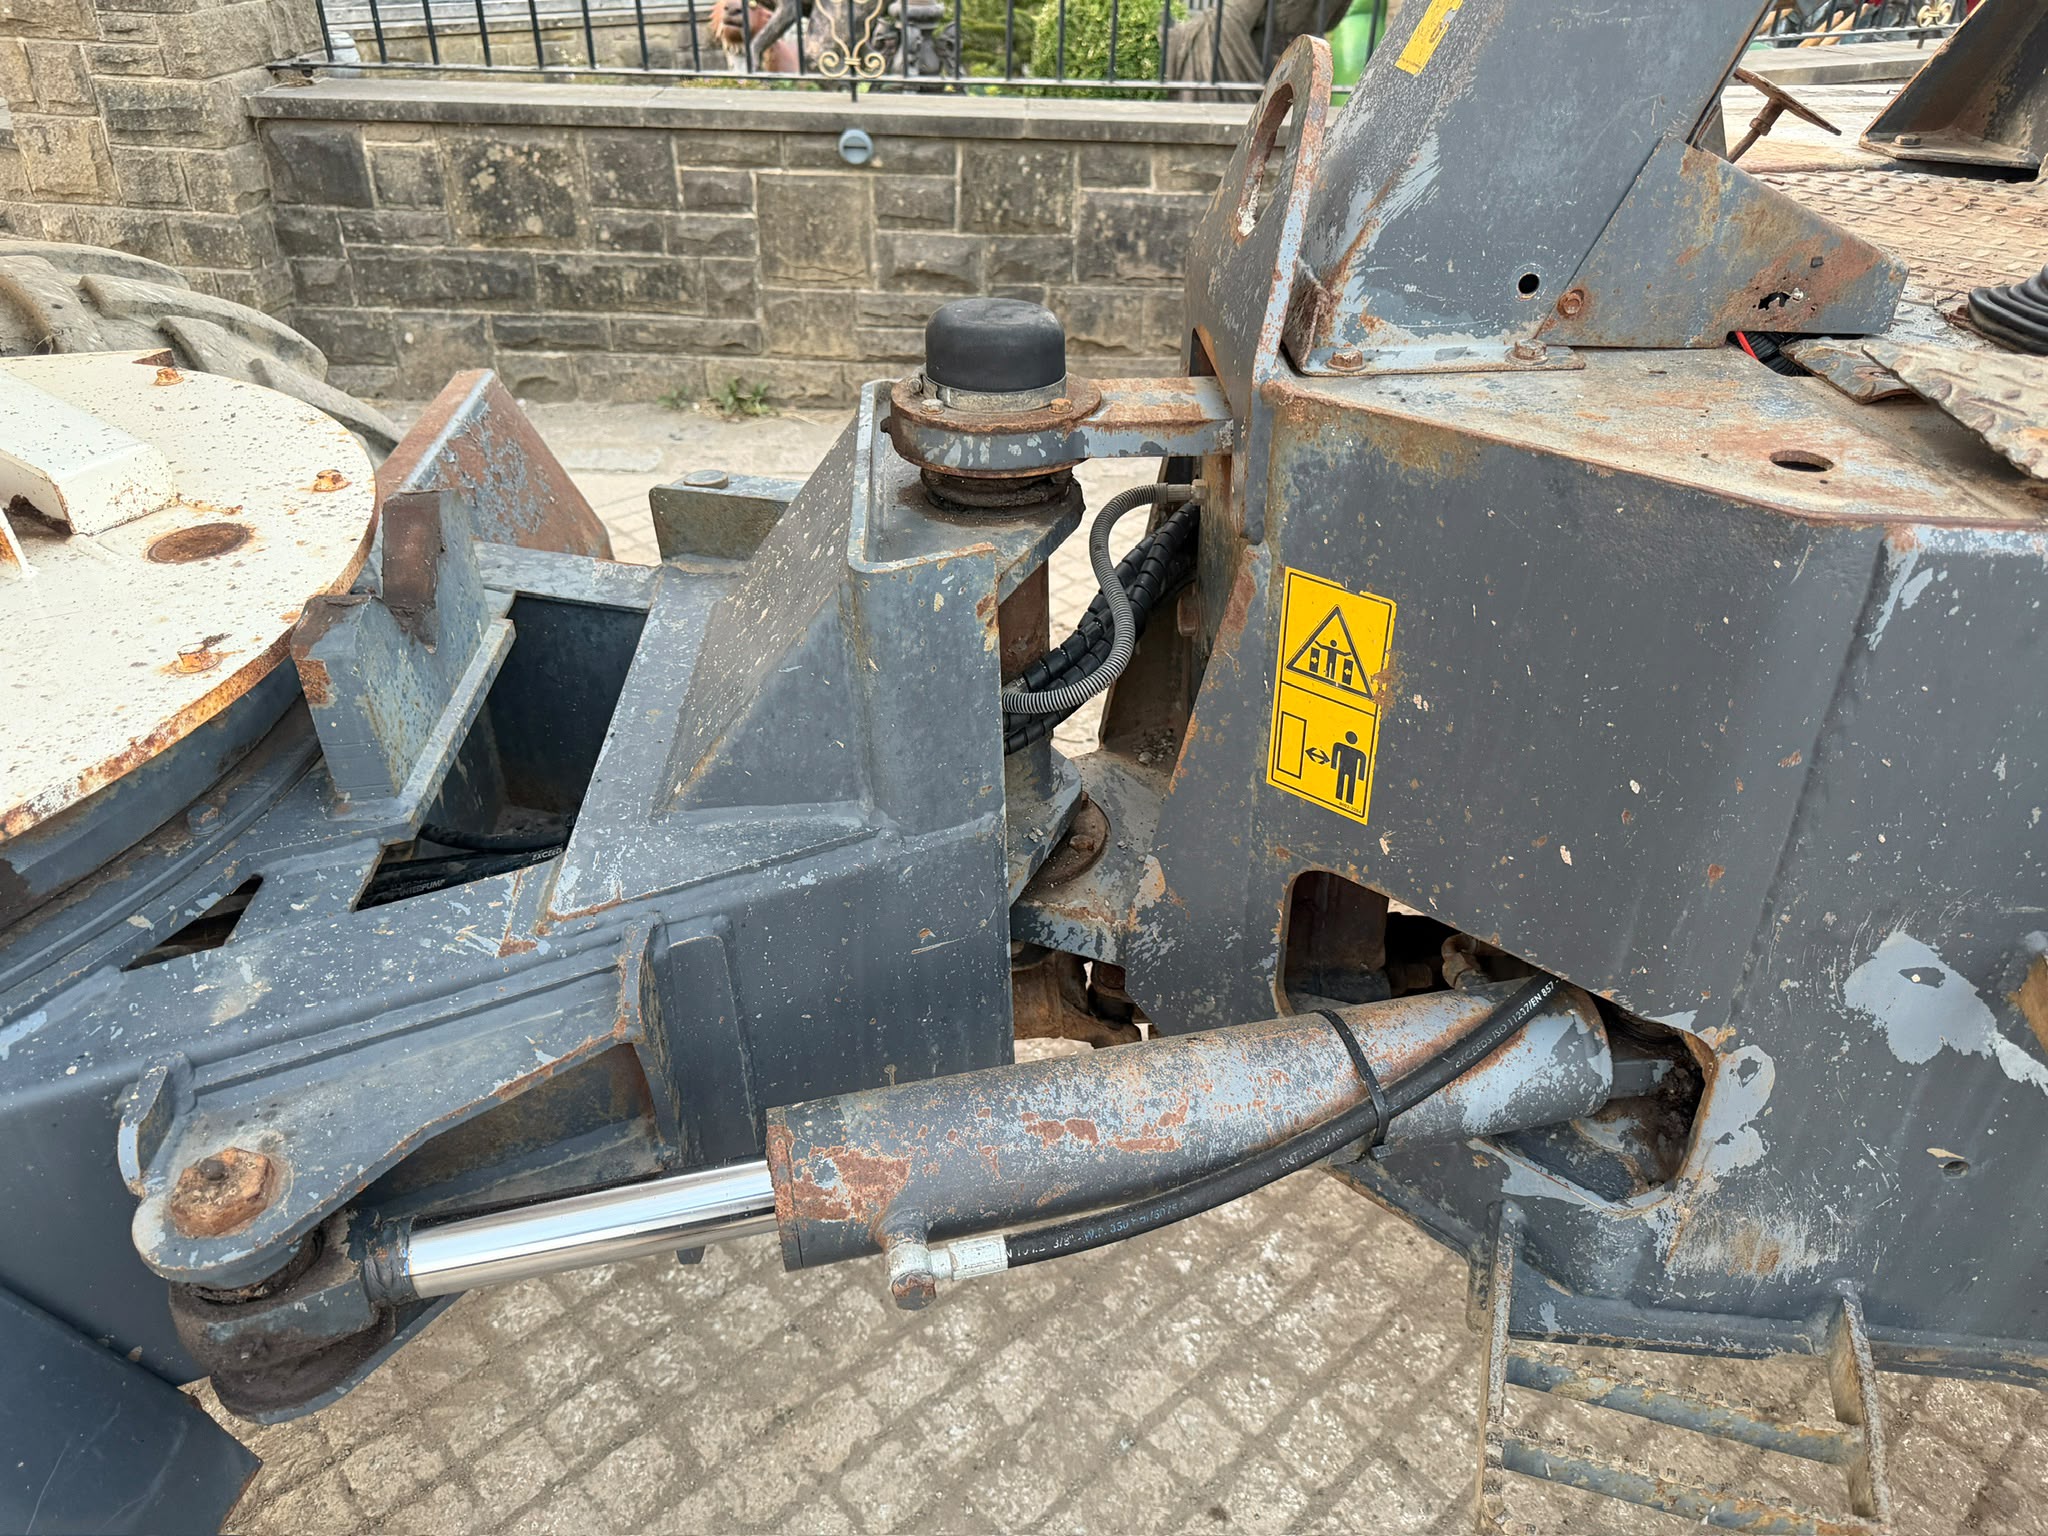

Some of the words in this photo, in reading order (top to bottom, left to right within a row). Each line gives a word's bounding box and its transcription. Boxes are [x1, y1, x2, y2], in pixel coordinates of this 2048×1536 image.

[1455, 1036, 1493, 1068] EXCEEDS
[1492, 1024, 1508, 1040] ISO
[1507, 993, 1543, 1026] 11237/EN
[1540, 981, 1555, 997] 857
